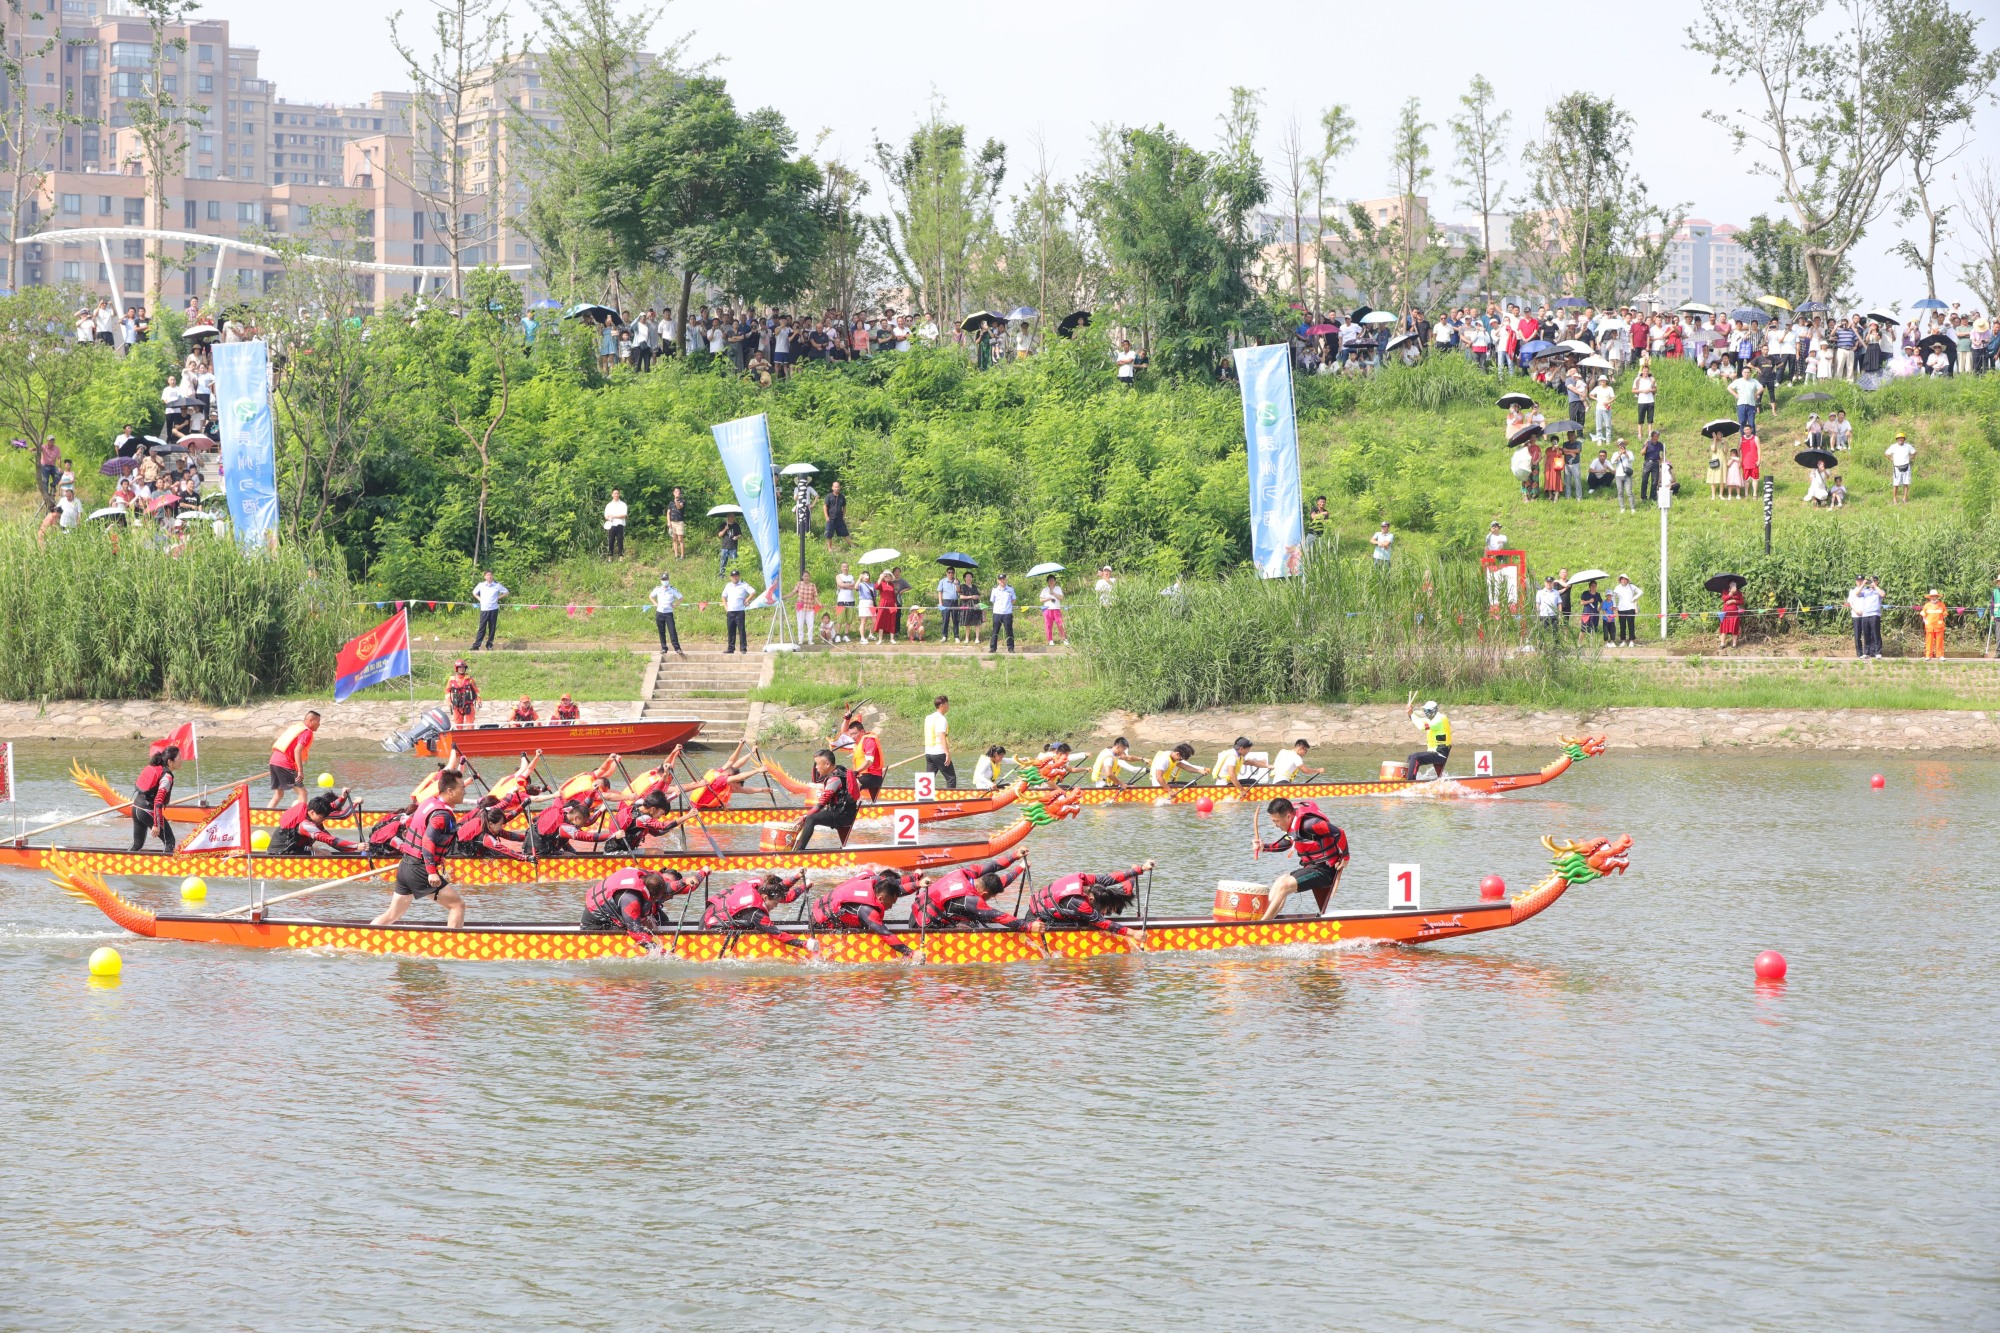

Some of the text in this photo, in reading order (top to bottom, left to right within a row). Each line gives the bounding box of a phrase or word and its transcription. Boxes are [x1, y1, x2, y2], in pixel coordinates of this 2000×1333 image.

[1478, 756, 1490, 772] 4
[919, 777, 932, 797] 3
[898, 815, 916, 839] 2
[1397, 871, 1412, 902] 1
